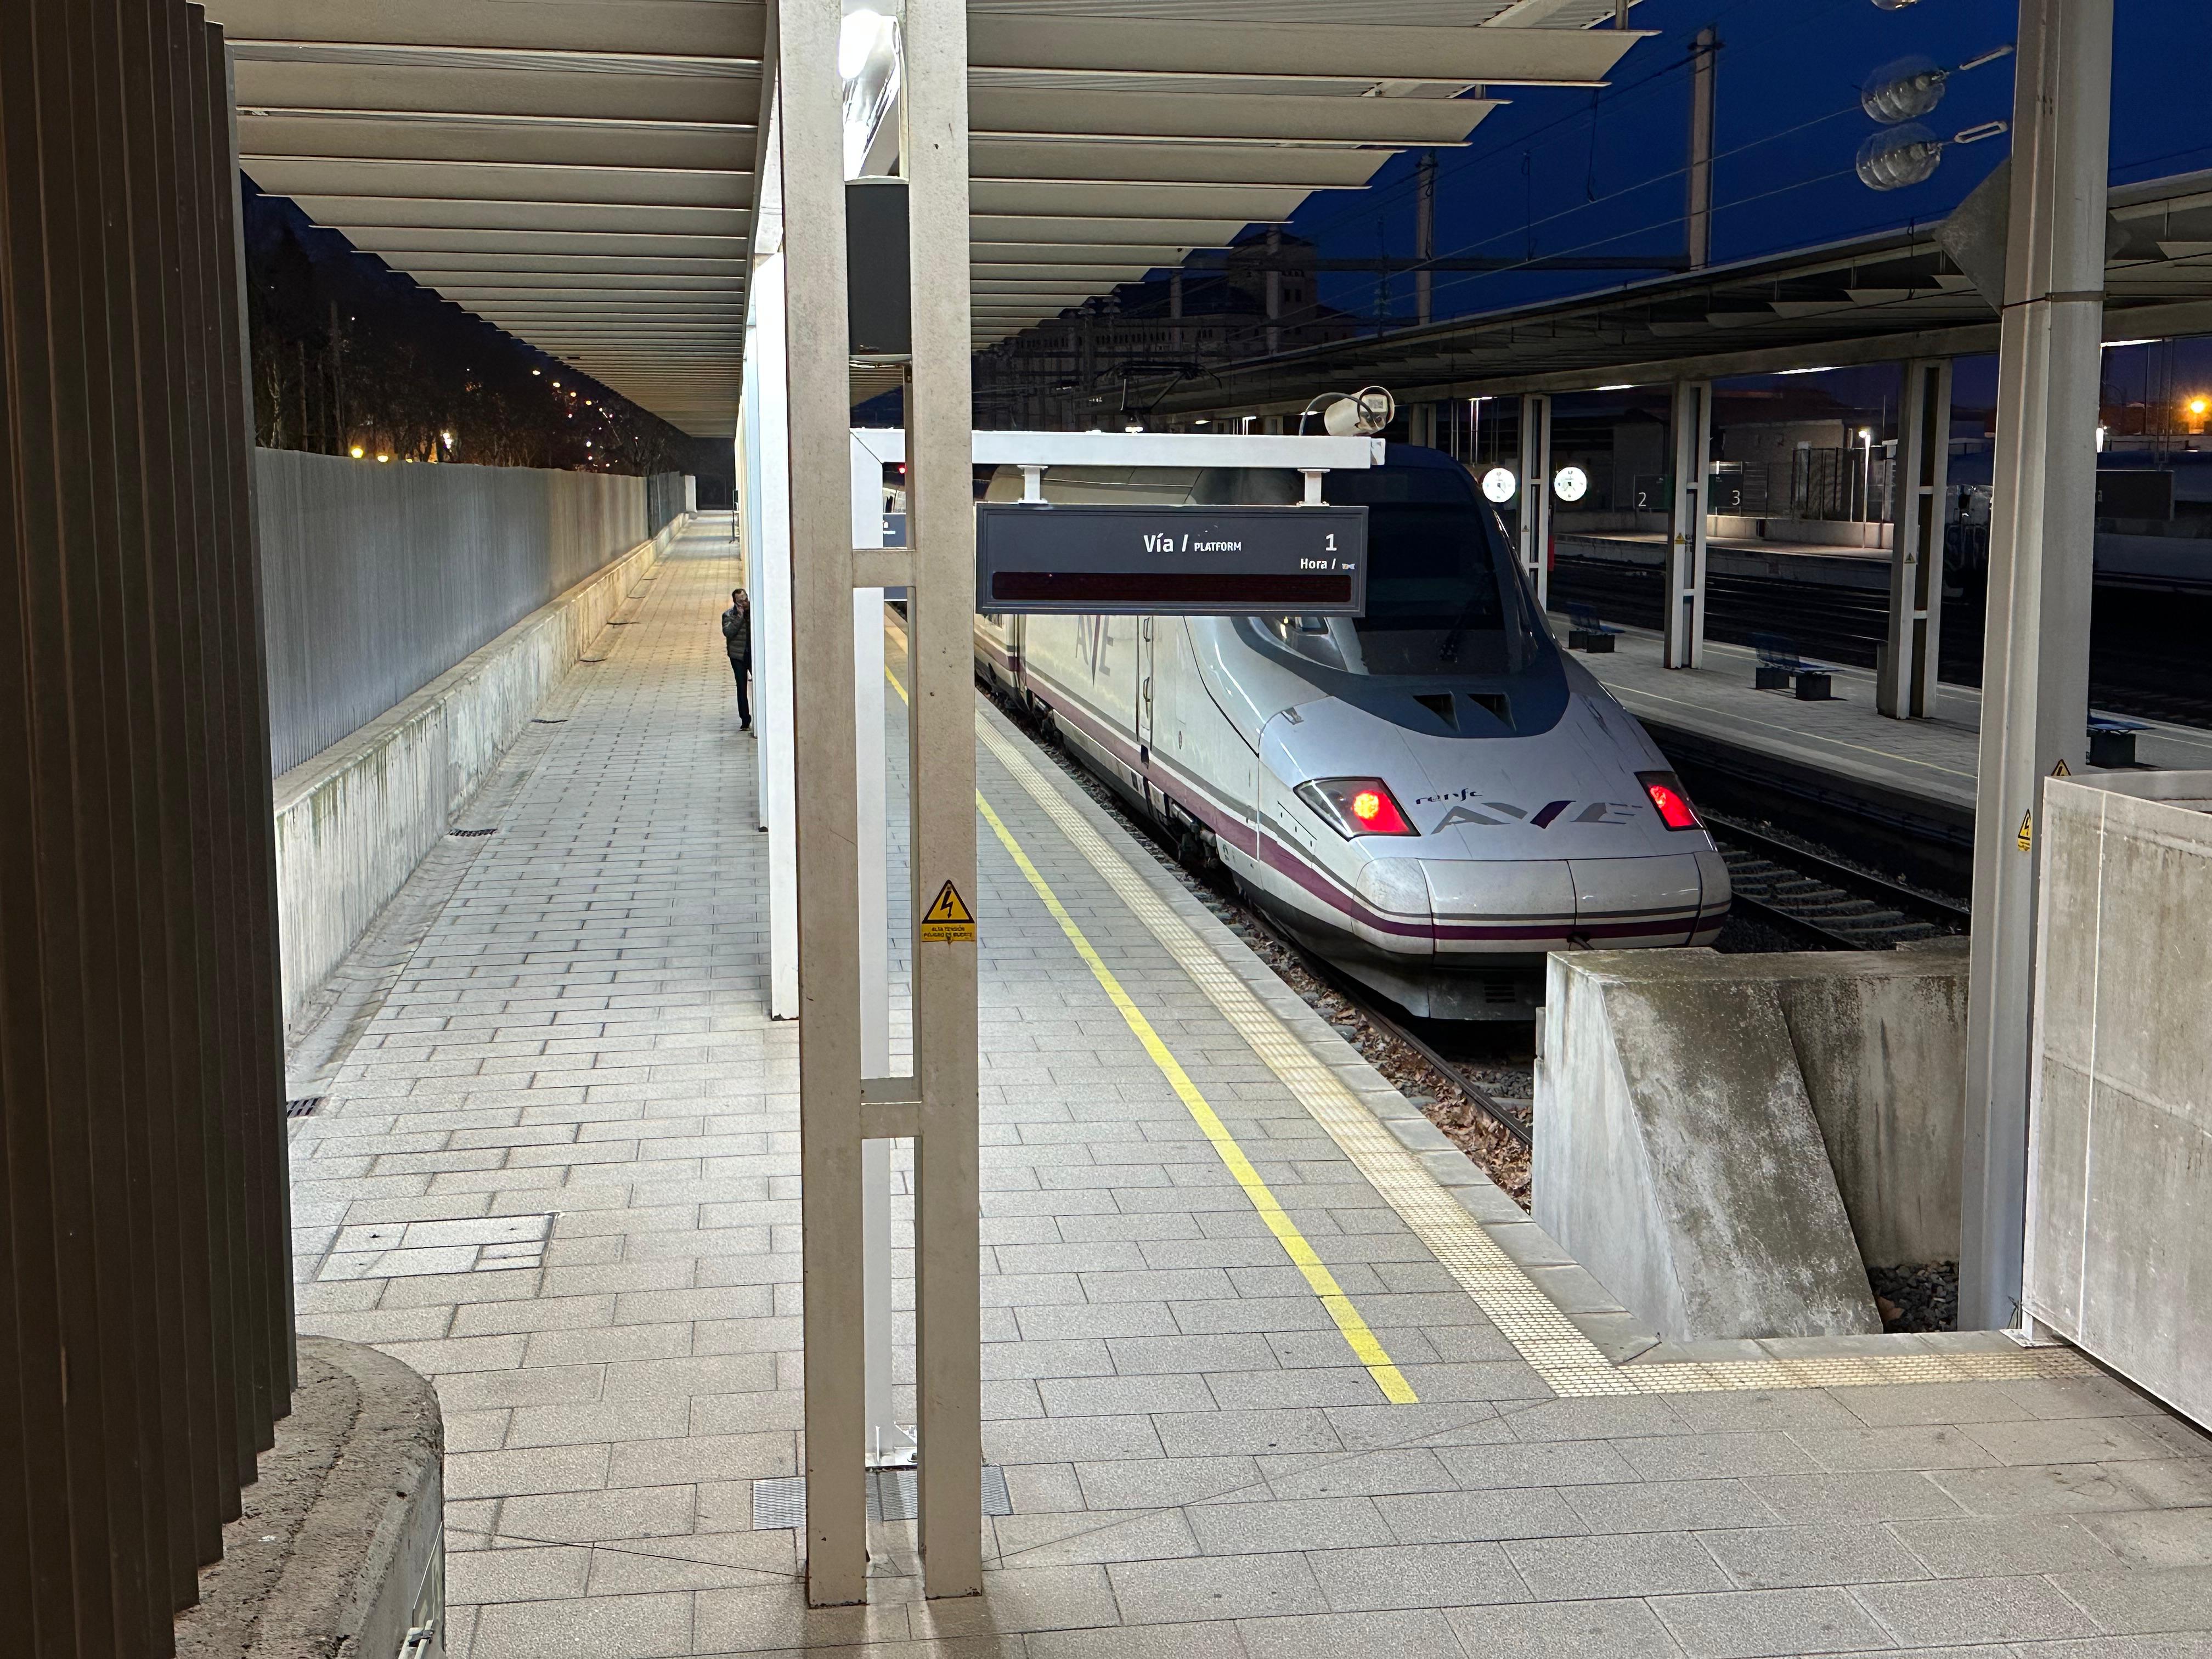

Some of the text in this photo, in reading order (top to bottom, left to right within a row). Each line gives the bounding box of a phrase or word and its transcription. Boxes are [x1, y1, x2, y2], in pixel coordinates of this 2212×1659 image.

[1638, 492, 1646, 507] 2
[1731, 490, 1740, 505] 3
[1143, 533, 1337, 552] Vía / PLATFORM 1
[1300, 558, 1327, 569] Hora
[1331, 558, 1336, 569] /
[1415, 787, 1483, 805] renfe
[1430, 800, 1643, 835] AVE
